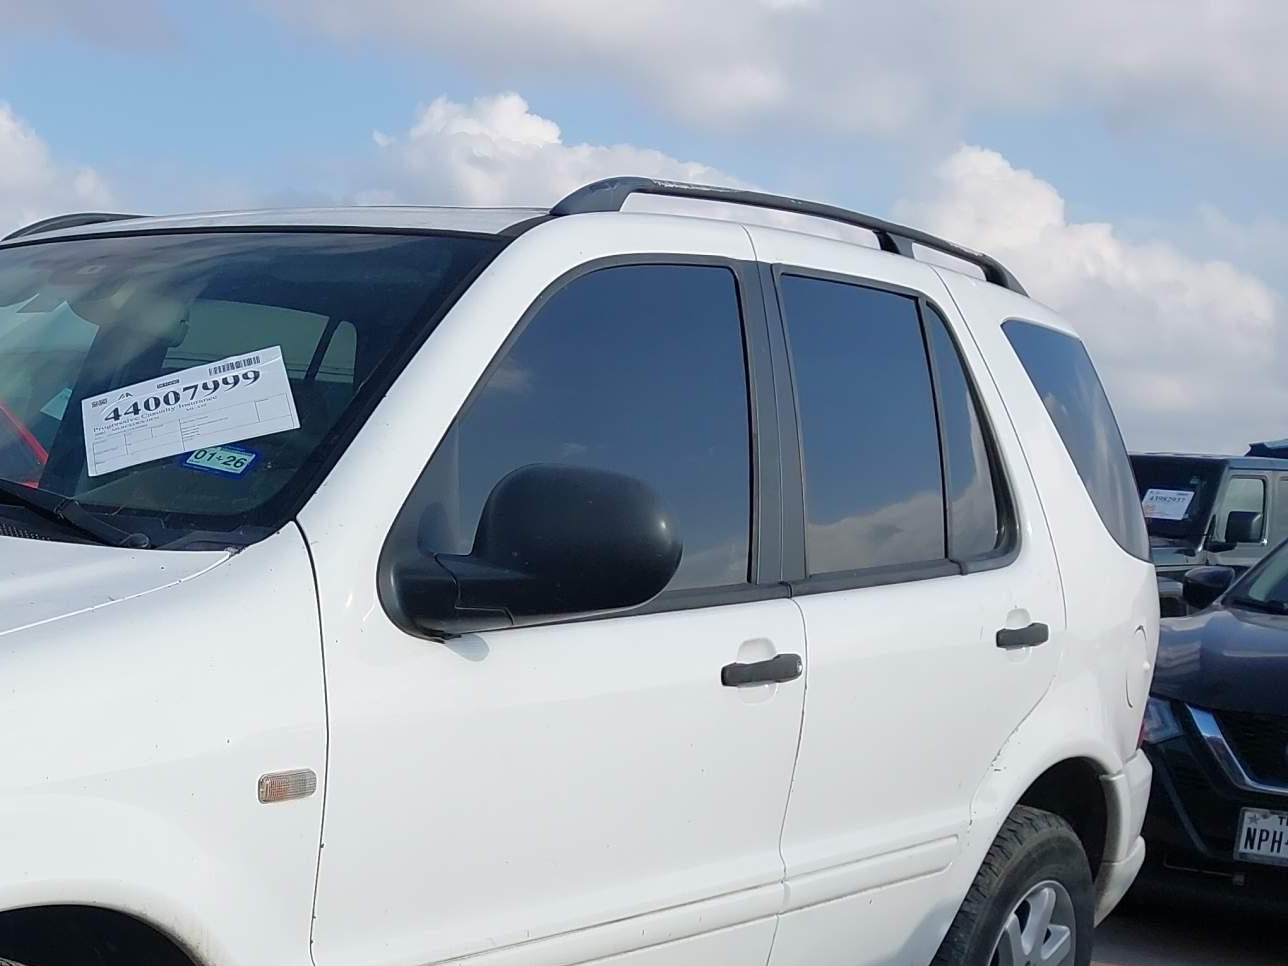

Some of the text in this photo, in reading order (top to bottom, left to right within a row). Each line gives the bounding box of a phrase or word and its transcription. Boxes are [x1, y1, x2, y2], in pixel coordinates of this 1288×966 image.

[94, 417, 140, 433] Progressive
[141, 406, 176, 421] Casualty
[177, 396, 218, 409] Insurance
[104, 370, 261, 422] 44007999
